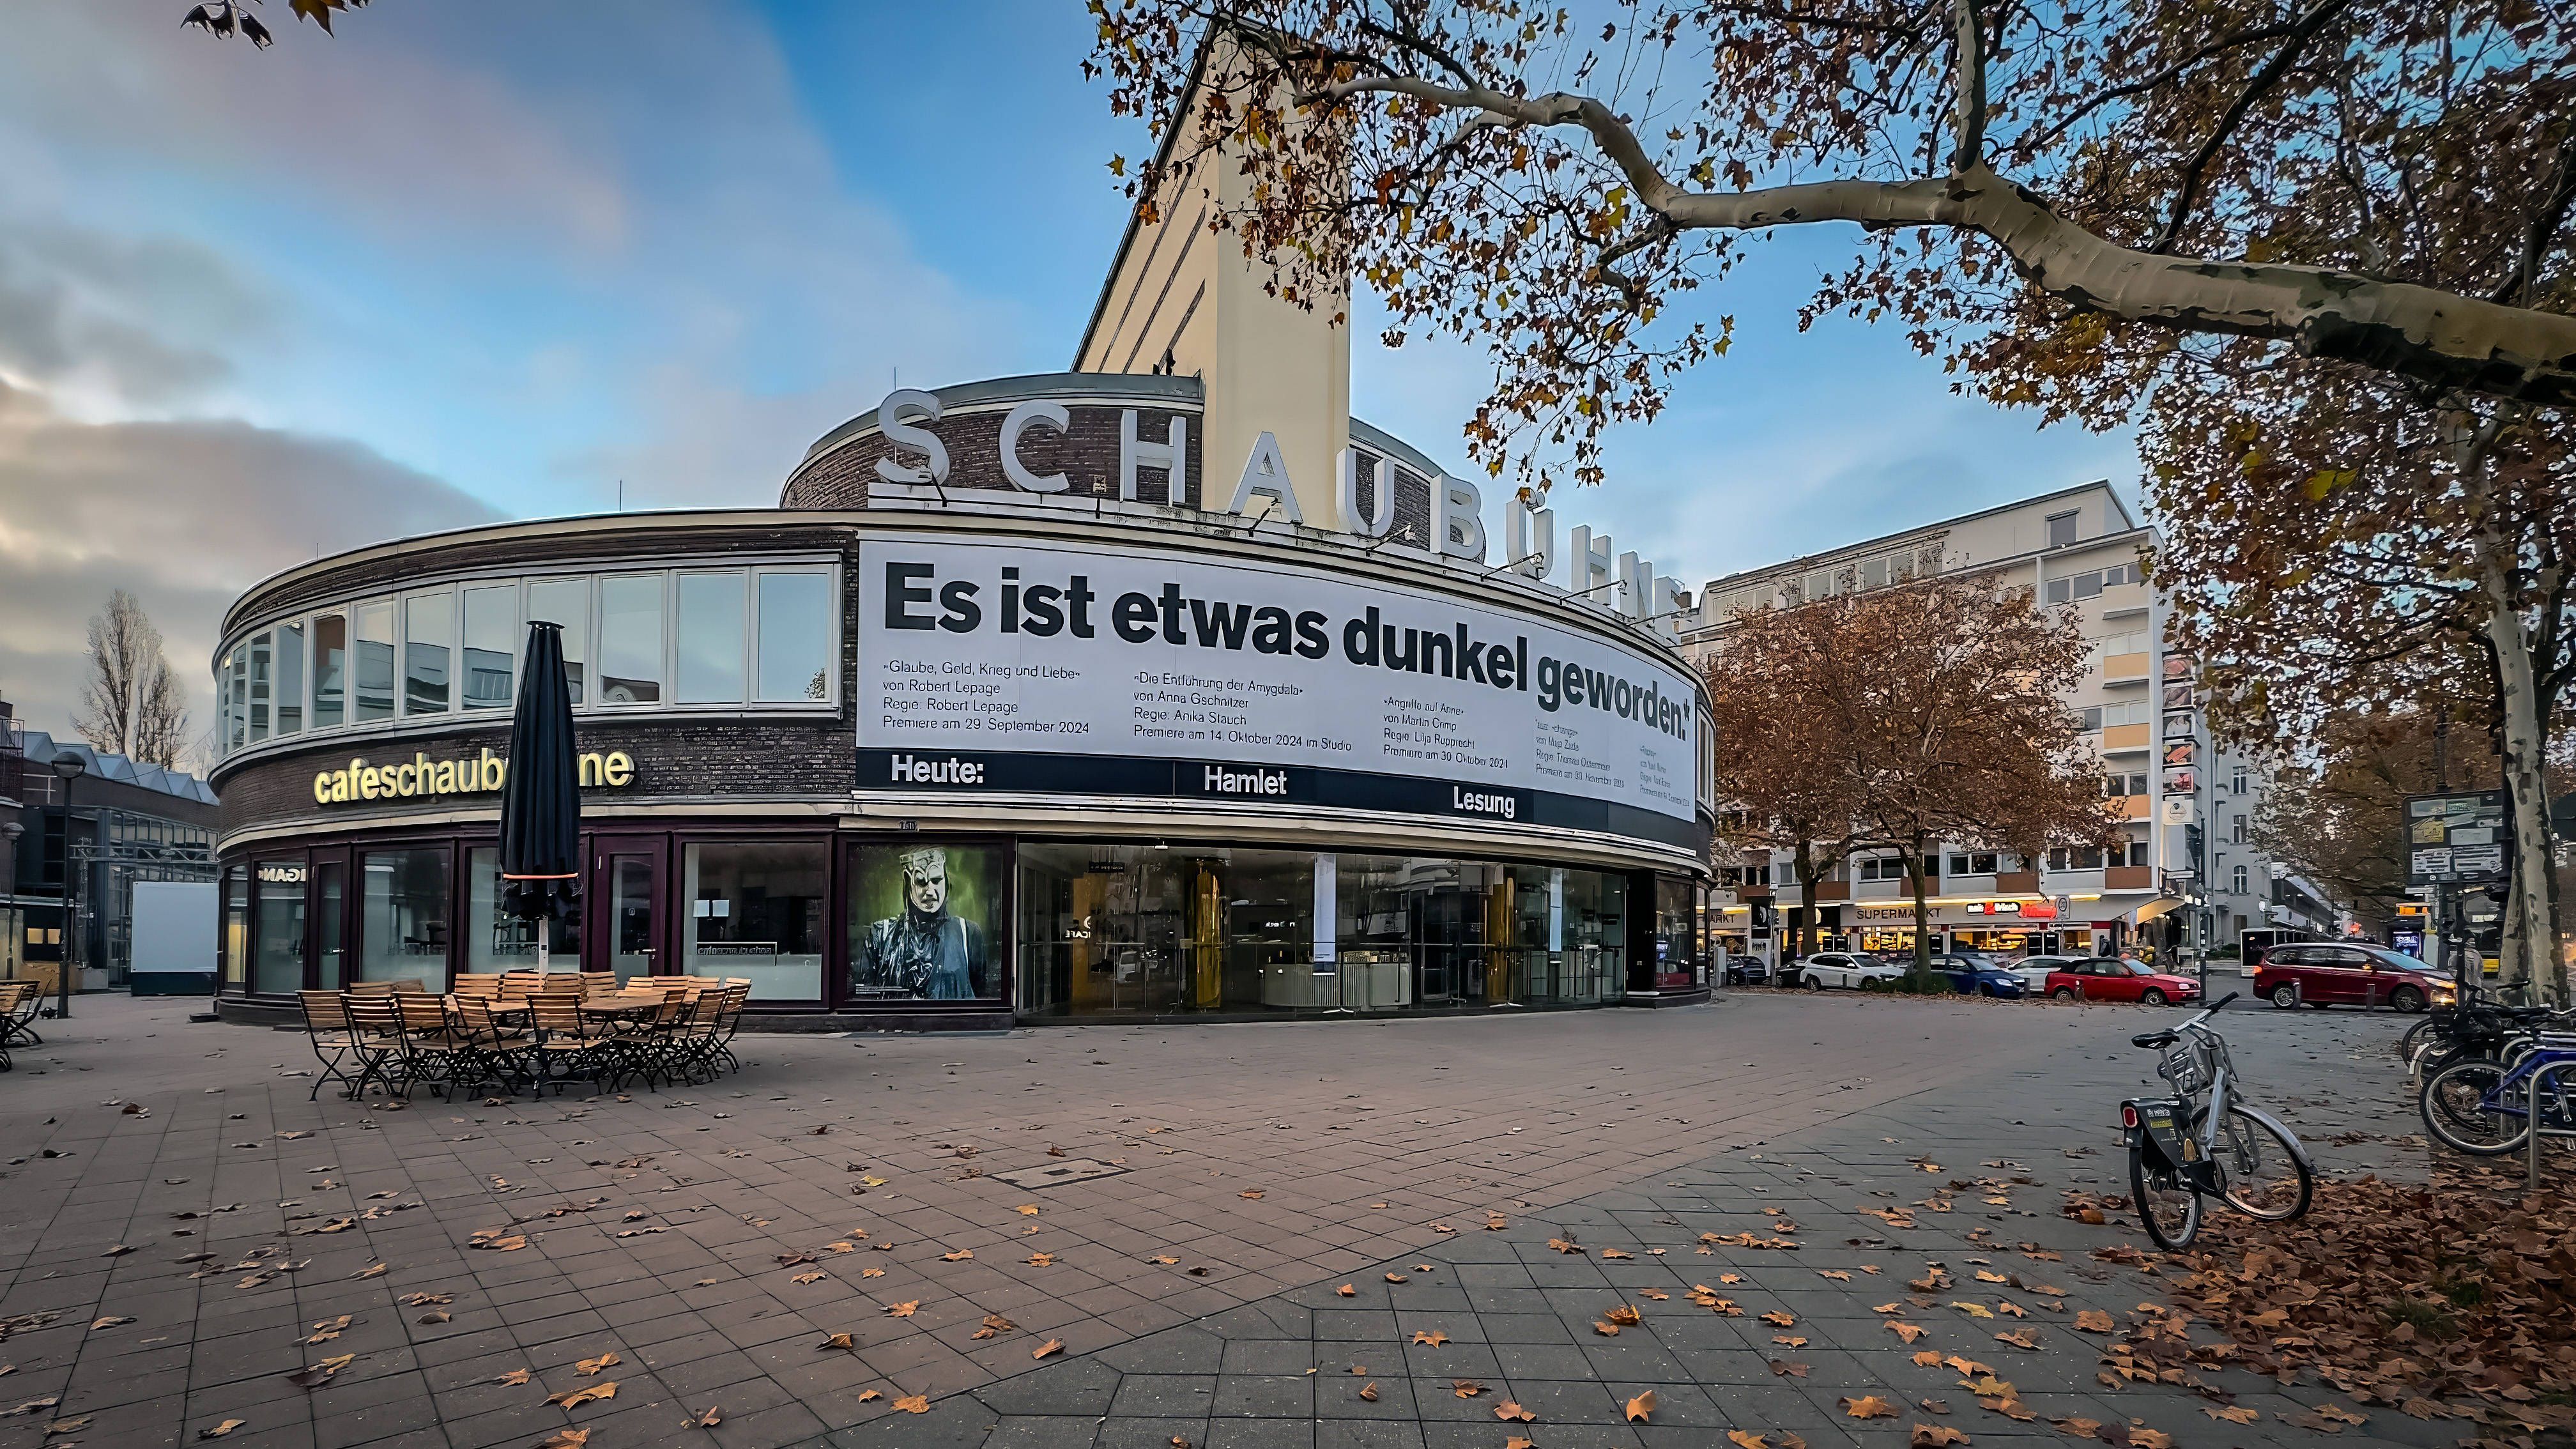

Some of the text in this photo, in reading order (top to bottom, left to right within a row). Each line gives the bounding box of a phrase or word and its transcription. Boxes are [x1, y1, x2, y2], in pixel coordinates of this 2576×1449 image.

[885, 562, 982, 634] Es
[1000, 567, 1095, 639] ist
[1112, 583, 1330, 660] etwas
[1343, 606, 1528, 692] dunkel
[942, 661, 975, 675] Geld,
[979, 663, 1011, 678] Krieg
[1016, 665, 1038, 677] und
[883, 679, 1000, 696] von Robert Lepage
[1163, 673, 1223, 691] Entführung
[1226, 678, 1244, 691] der
[927, 698, 968, 711] Robert
[973, 699, 1018, 715] Lepage
[1133, 691, 1248, 709] von Anna Gschnitzer
[884, 716, 937, 729] Premiere
[942, 720, 960, 729] am
[988, 718, 1055, 733] September
[1059, 721, 1089, 733] 2024
[1134, 707, 1246, 725] Regie: Anika Stauch
[1383, 714, 1399, 724] von
[1402, 714, 1429, 727] Martin
[1134, 724, 1351, 751] Premiere am 14. Oktober 2024 im Studio
[1425, 751, 1438, 760] am
[314, 747, 636, 804] cafeschaubne
[891, 754, 984, 785] Heute:
[1204, 766, 1287, 795] Hamlet
[1453, 786, 1515, 820] Lesung
[1857, 908, 1942, 920] SUPERMAKT
